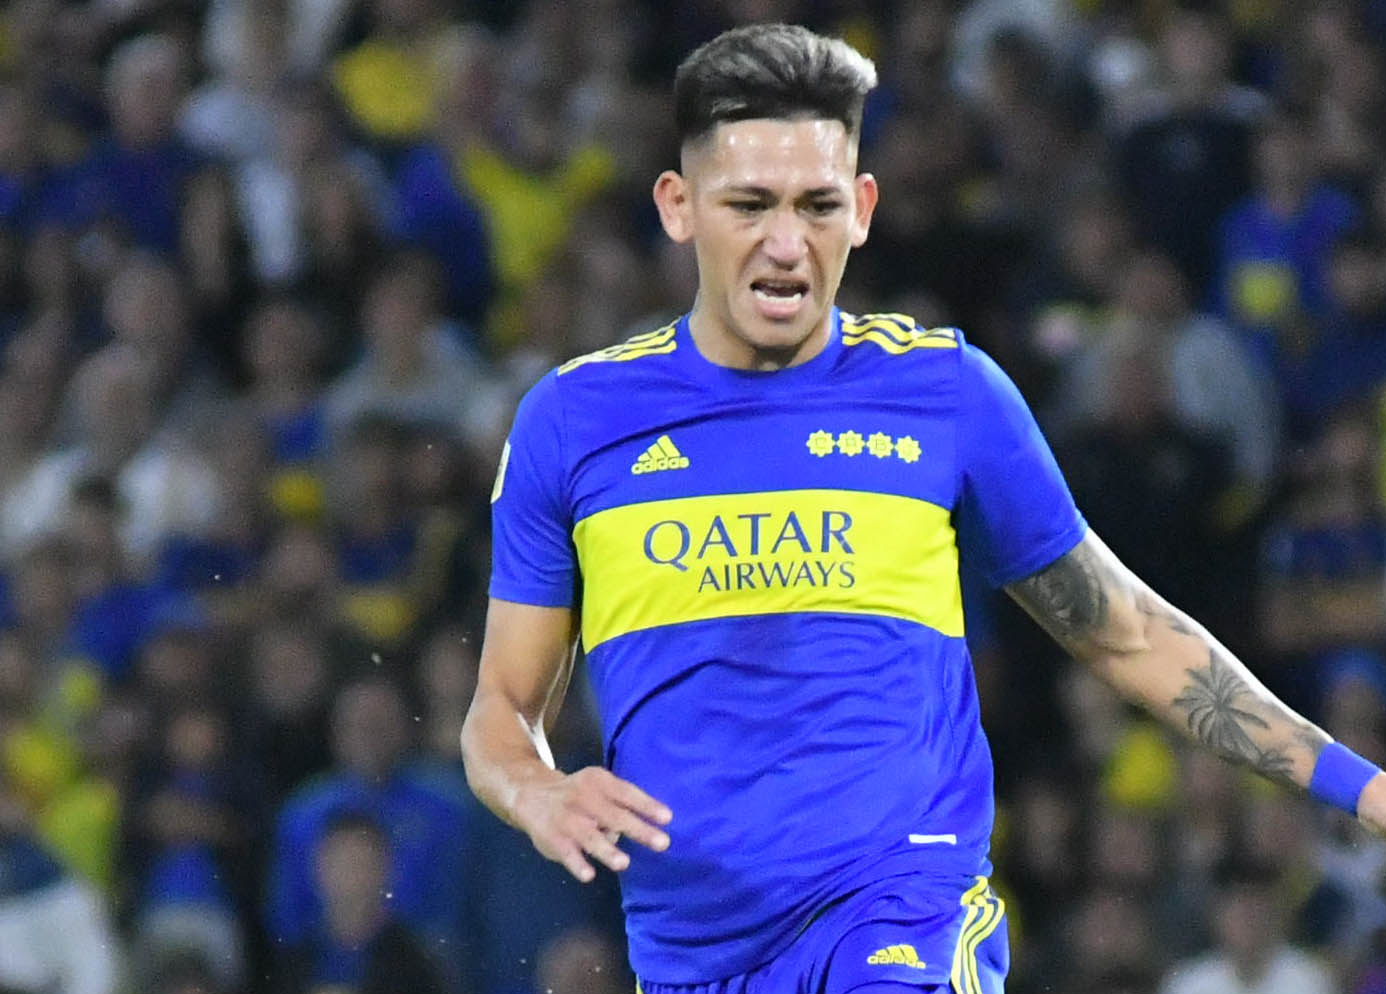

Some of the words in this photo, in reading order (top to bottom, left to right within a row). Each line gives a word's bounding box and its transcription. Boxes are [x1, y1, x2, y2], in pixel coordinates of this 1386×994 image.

[631, 456, 690, 475] adidas
[643, 510, 856, 573] QATAR
[697, 560, 856, 593] AIRWAYS
